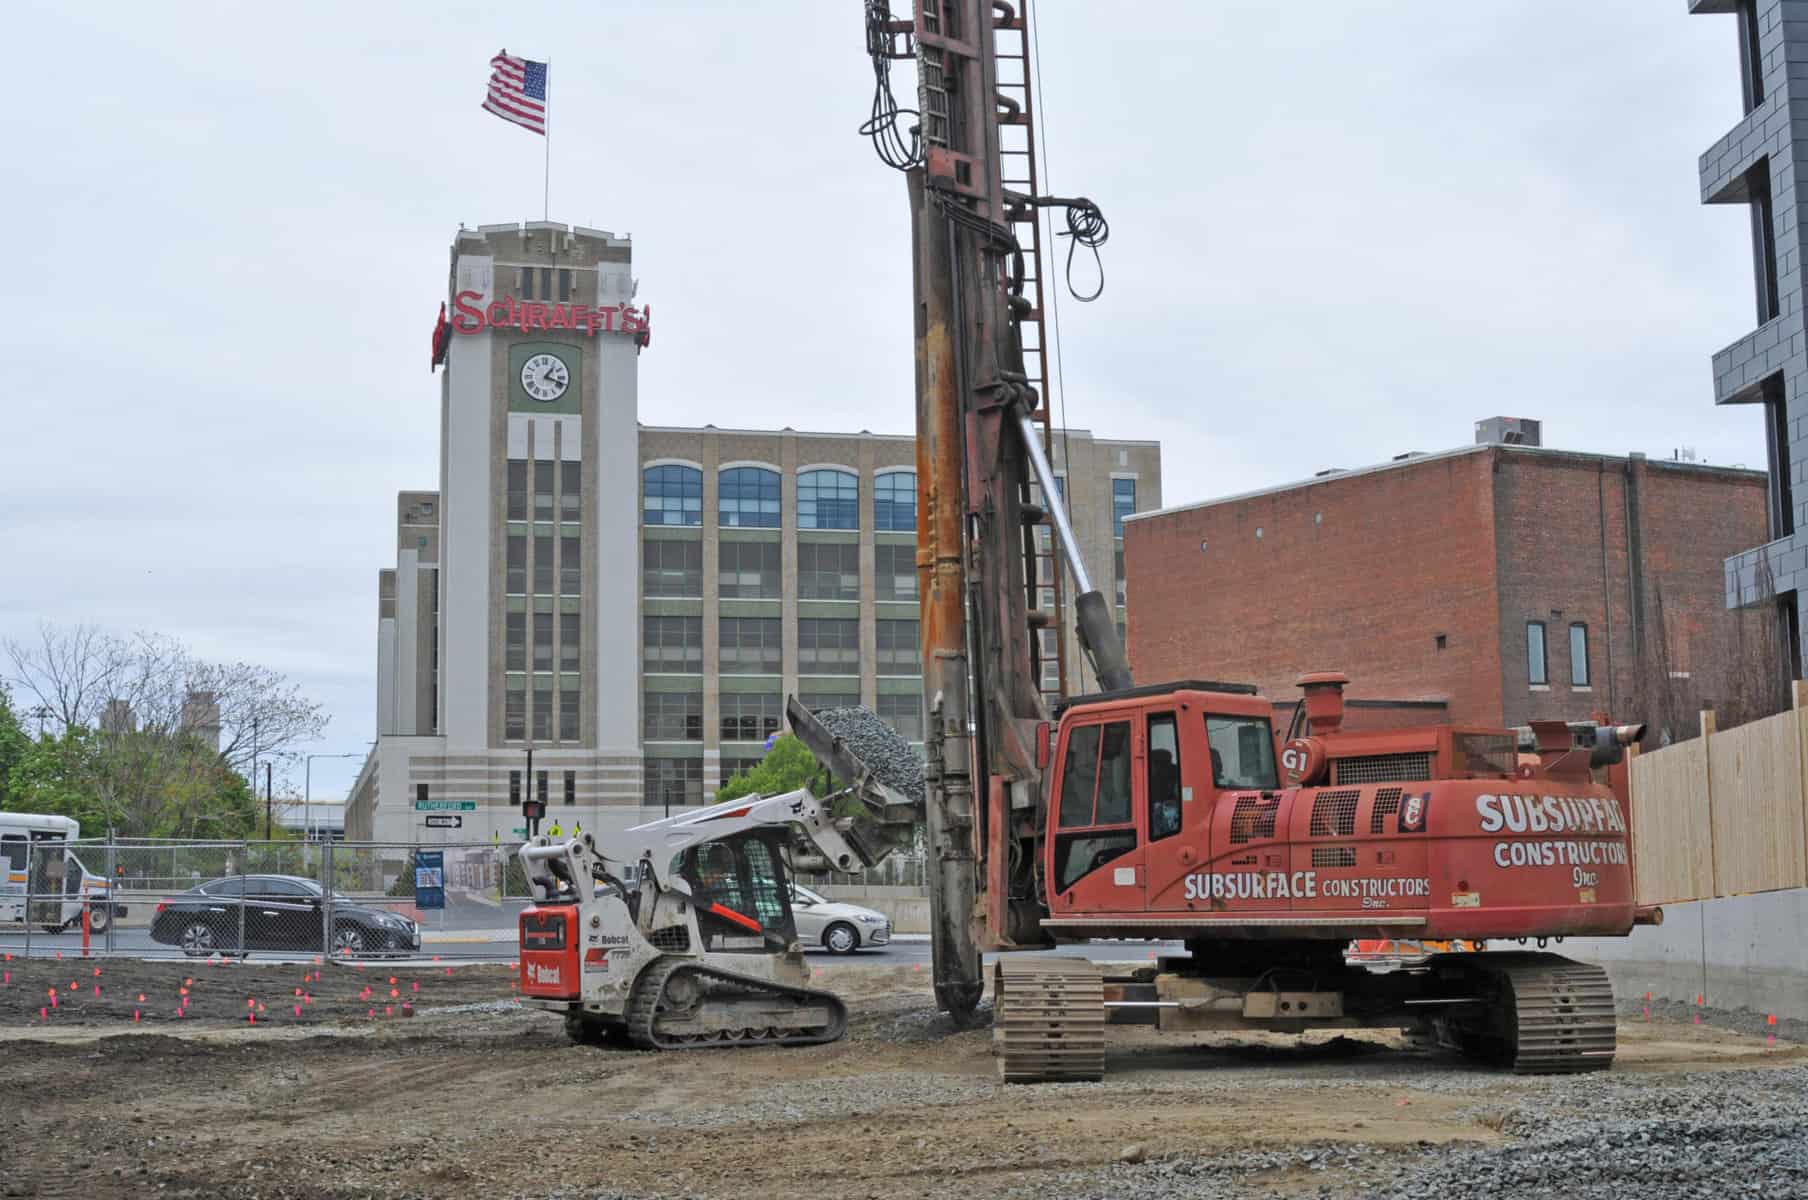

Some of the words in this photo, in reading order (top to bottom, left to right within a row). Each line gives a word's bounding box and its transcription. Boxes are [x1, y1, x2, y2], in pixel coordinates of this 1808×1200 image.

[451, 290, 641, 336] SCHRAFFT'S
[1281, 749, 1307, 771] G1
[1184, 872, 1316, 899] SUBSURFACE
[1322, 878, 1429, 896] CONSTRUCTORS
[601, 935, 628, 945] Bobcat
